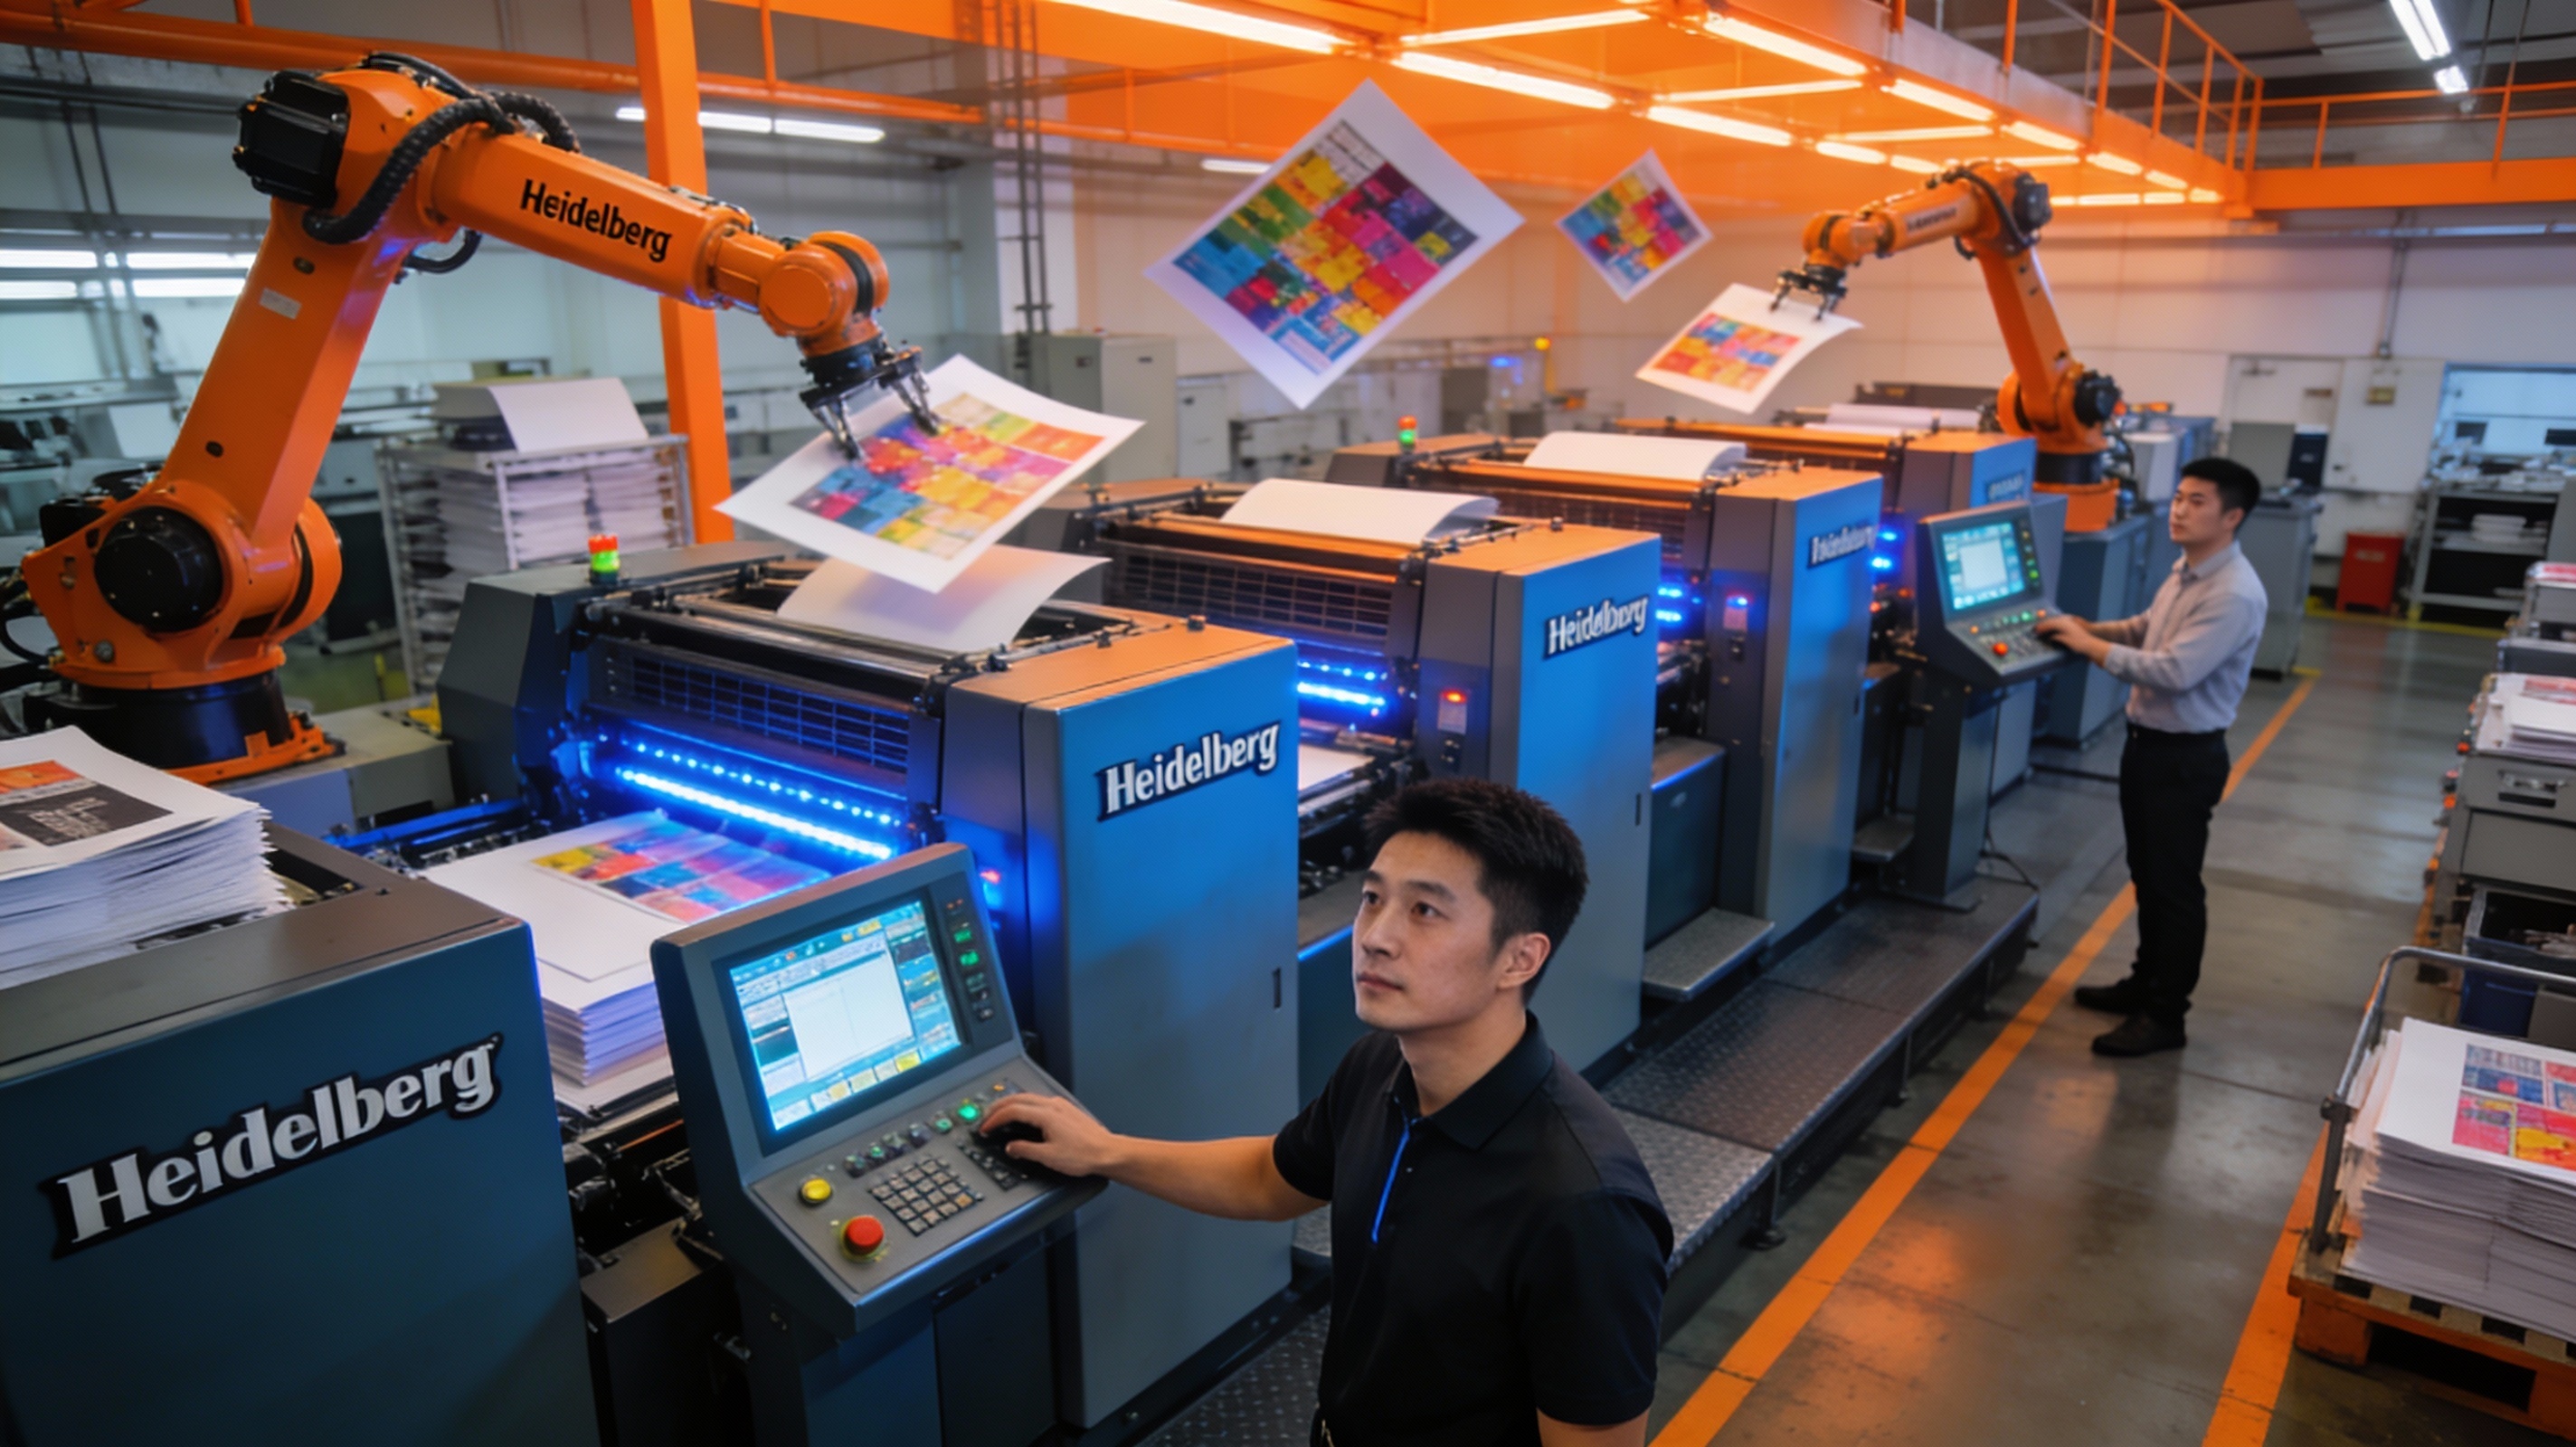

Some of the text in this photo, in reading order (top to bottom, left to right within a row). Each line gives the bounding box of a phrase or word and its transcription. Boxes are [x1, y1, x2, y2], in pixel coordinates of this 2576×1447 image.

[520, 178, 672, 263] Heidelberg
[1105, 724, 1280, 814] Heidelberg
[56, 1036, 498, 1244] Heidelberg
